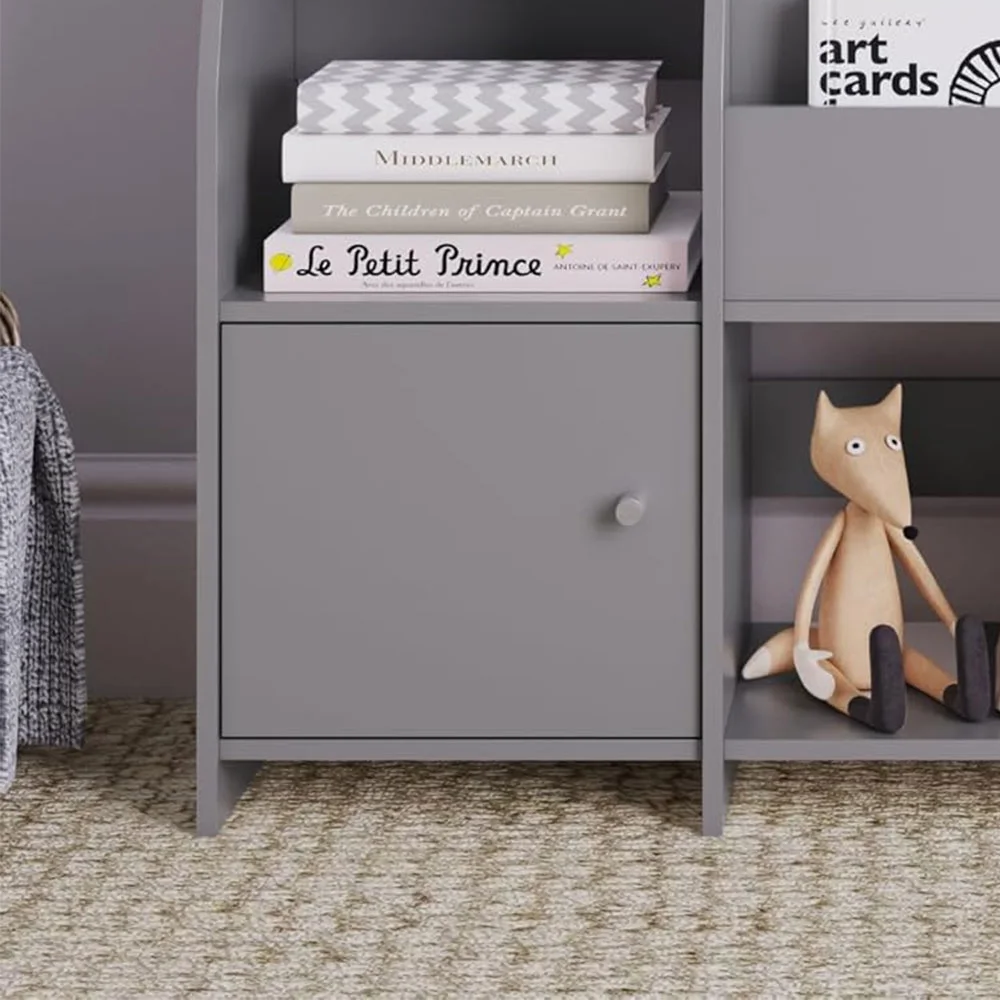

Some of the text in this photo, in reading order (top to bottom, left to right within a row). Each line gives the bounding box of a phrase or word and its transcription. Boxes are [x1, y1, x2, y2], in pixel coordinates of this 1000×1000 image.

[819, 33, 888, 65] art
[819, 63, 939, 96] cards
[374, 149, 557, 167] MIDDLEMARCH
[322, 203, 628, 221] The Children of Captain Grant
[296, 243, 541, 277] Le Petit Prince
